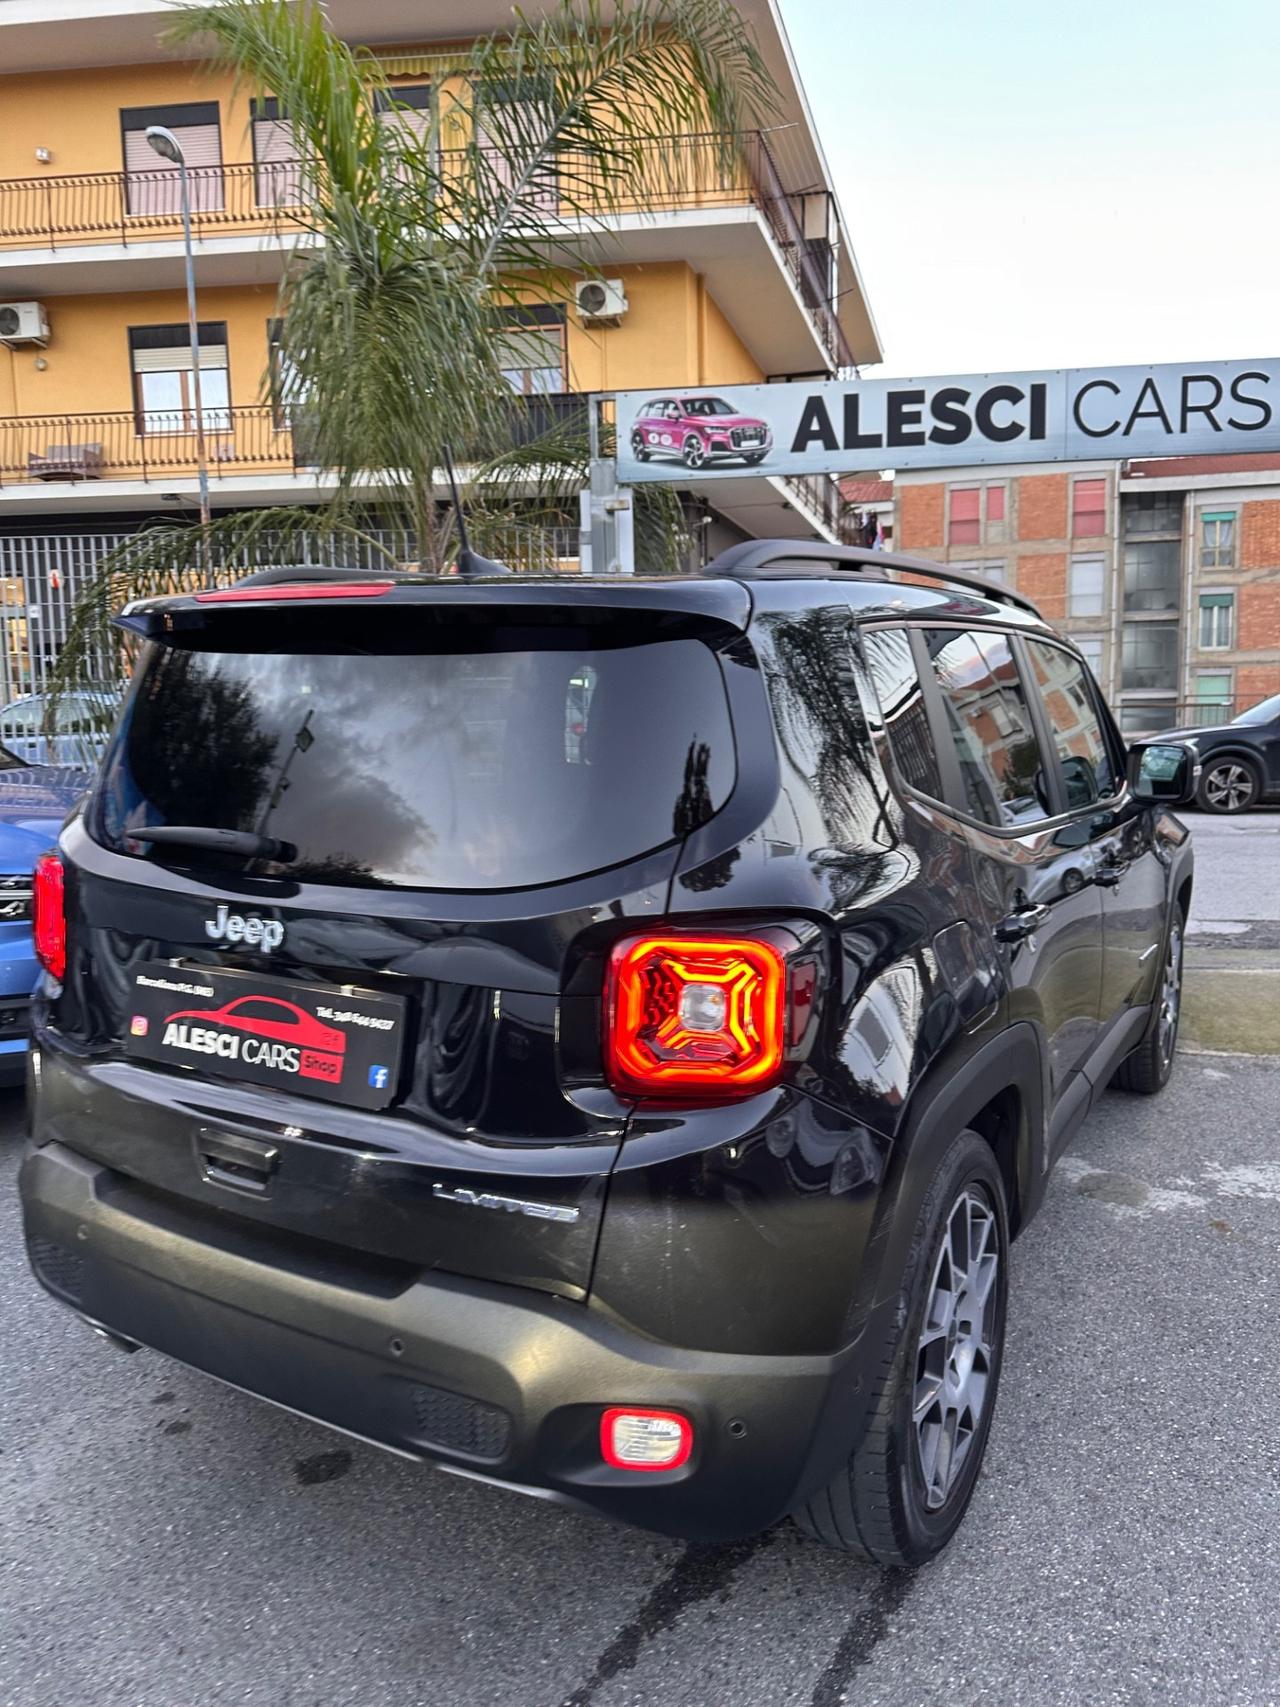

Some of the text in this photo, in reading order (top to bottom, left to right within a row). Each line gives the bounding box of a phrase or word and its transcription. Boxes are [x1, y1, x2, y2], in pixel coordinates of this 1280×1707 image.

[790, 371, 1272, 453] ALESCI CARS
[205, 905, 285, 953] Jeep
[162, 1023, 337, 1076] ALESCI CARS Shop
